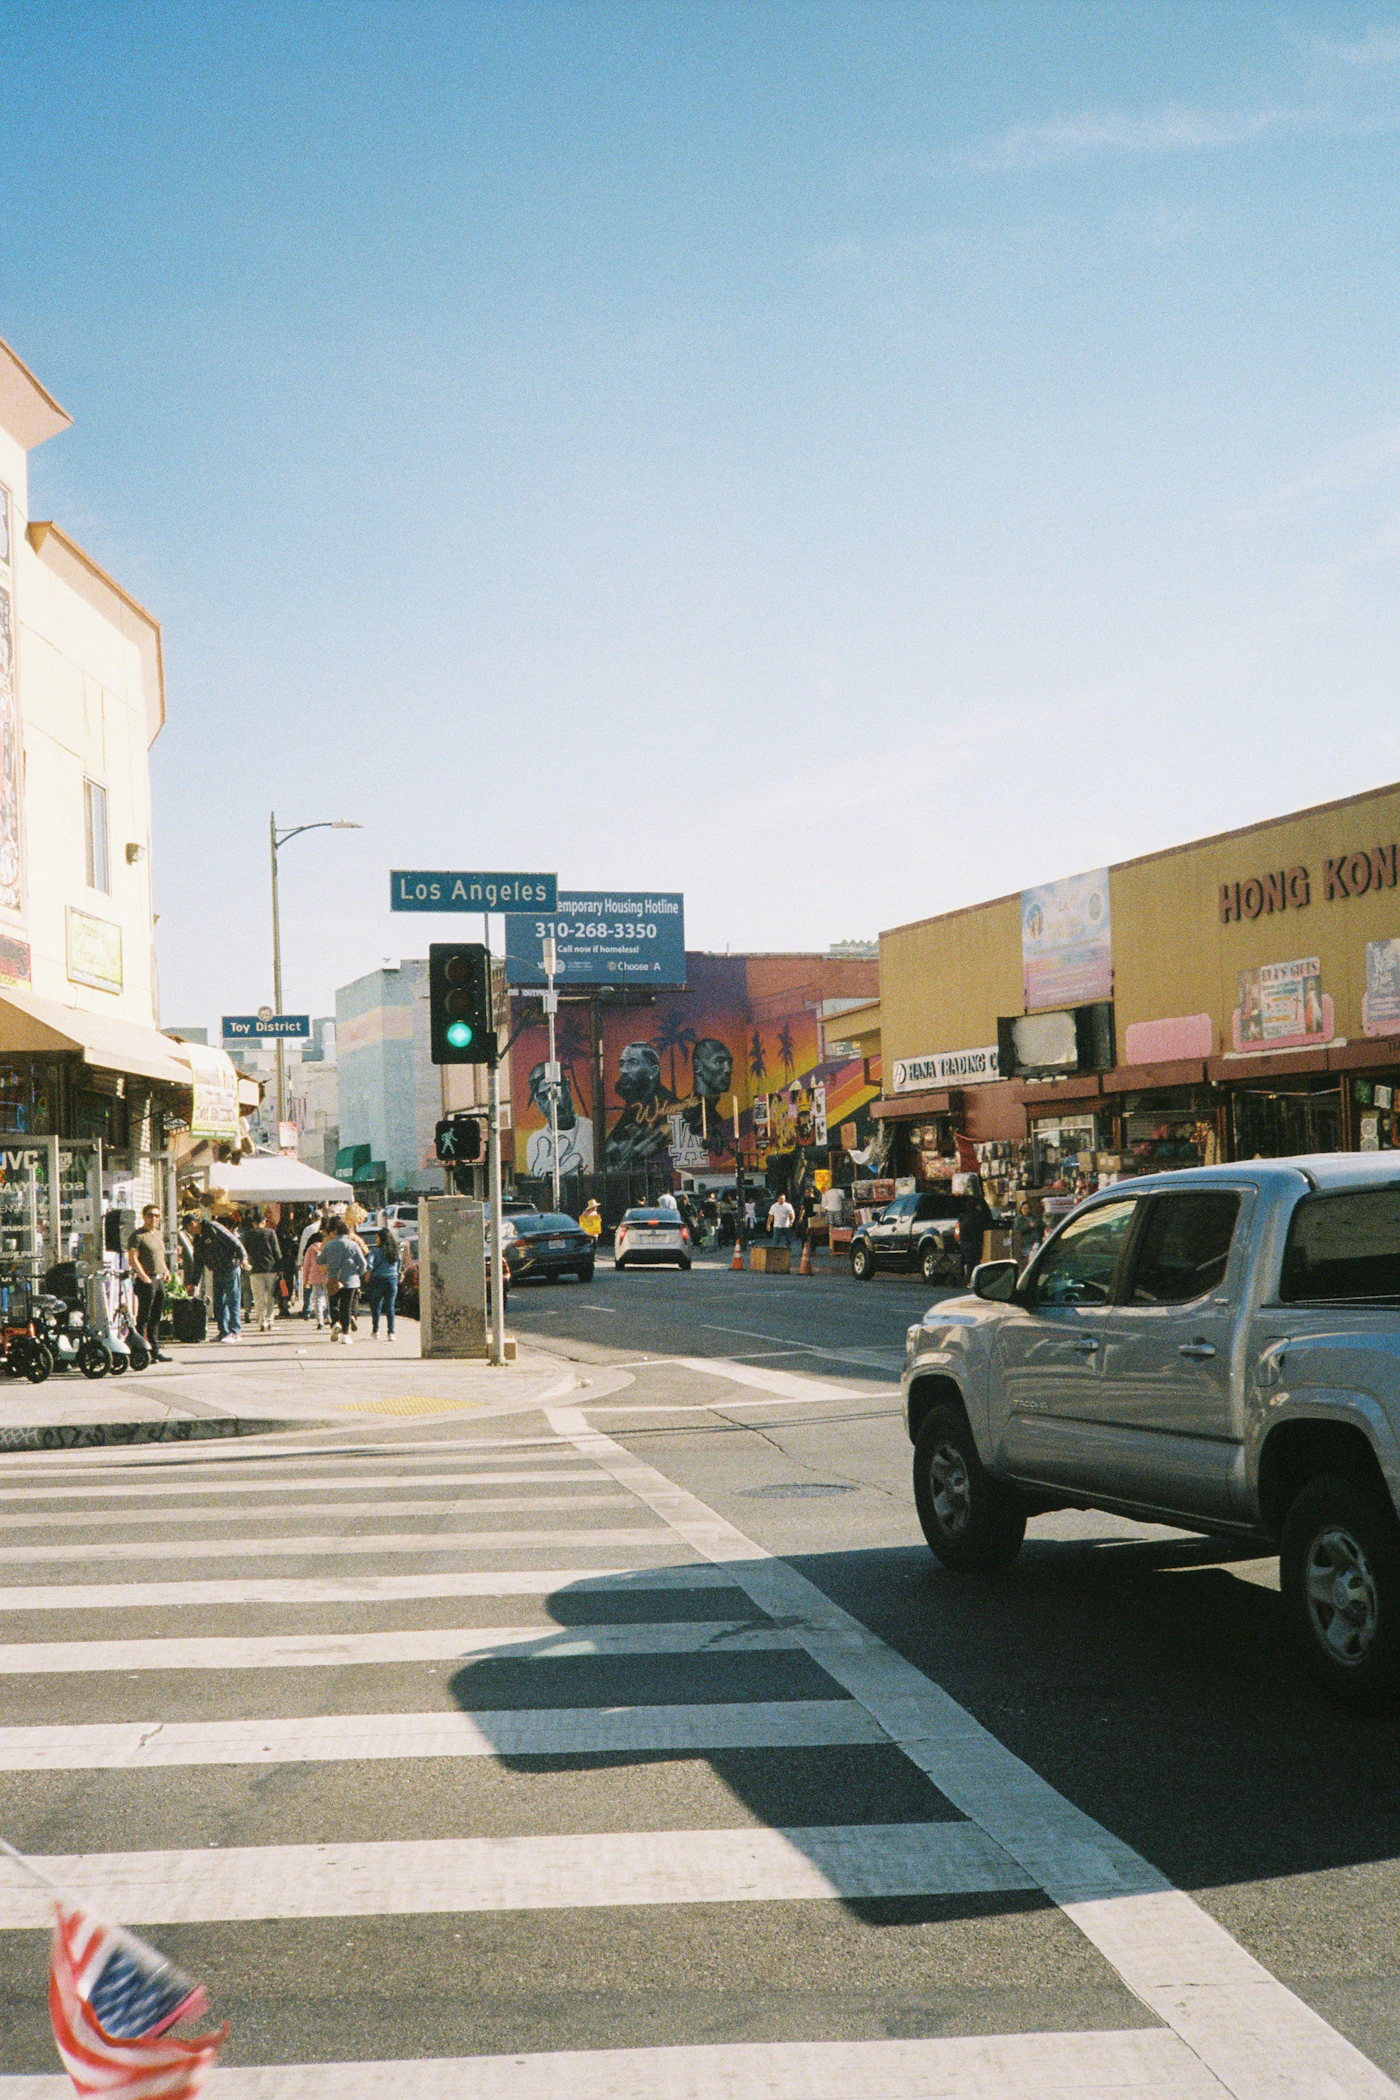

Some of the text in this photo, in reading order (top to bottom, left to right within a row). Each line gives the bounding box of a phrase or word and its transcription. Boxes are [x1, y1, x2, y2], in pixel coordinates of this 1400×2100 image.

[400, 879, 547, 907] Los Angeles
[1218, 843, 1400, 924] HONG KON
[558, 899, 679, 917] emporary Housing Hotline
[535, 922, 657, 938] 310-268-3350
[557, 945, 573, 953] Call
[592, 945, 599, 953] if
[600, 945, 640, 954] homeless!
[617, 962, 649, 971] Choose
[230, 1021, 302, 1034] Toy District
[908, 1061, 937, 1080] HANA
[938, 1053, 986, 1077] TRADING
[667, 1112, 710, 1168] LA
[0, 1150, 38, 1170] JVC
